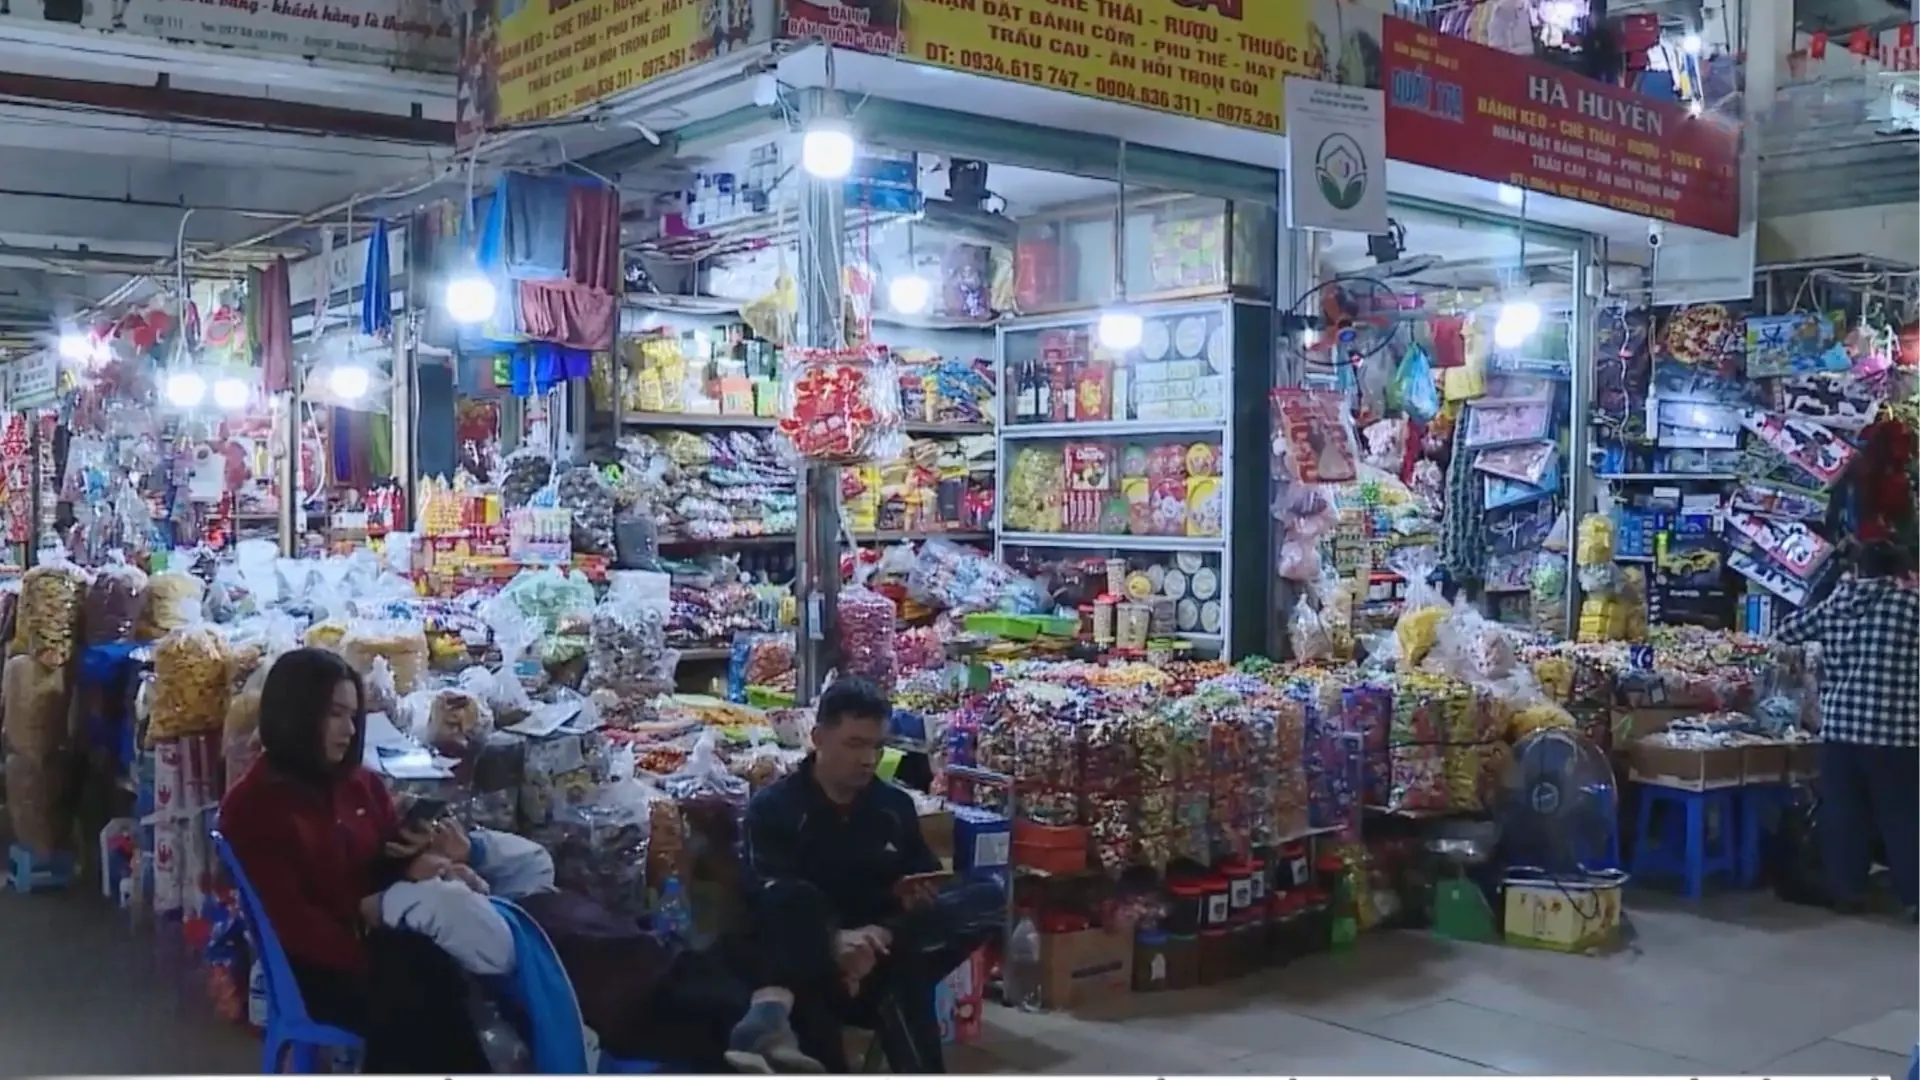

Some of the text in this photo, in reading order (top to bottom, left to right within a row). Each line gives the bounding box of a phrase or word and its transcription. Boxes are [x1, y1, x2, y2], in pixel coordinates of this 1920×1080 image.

[1049, 38, 1089, 59] CAU
[1048, 66, 1079, 88] 747
[1174, 94, 1200, 114] 311
